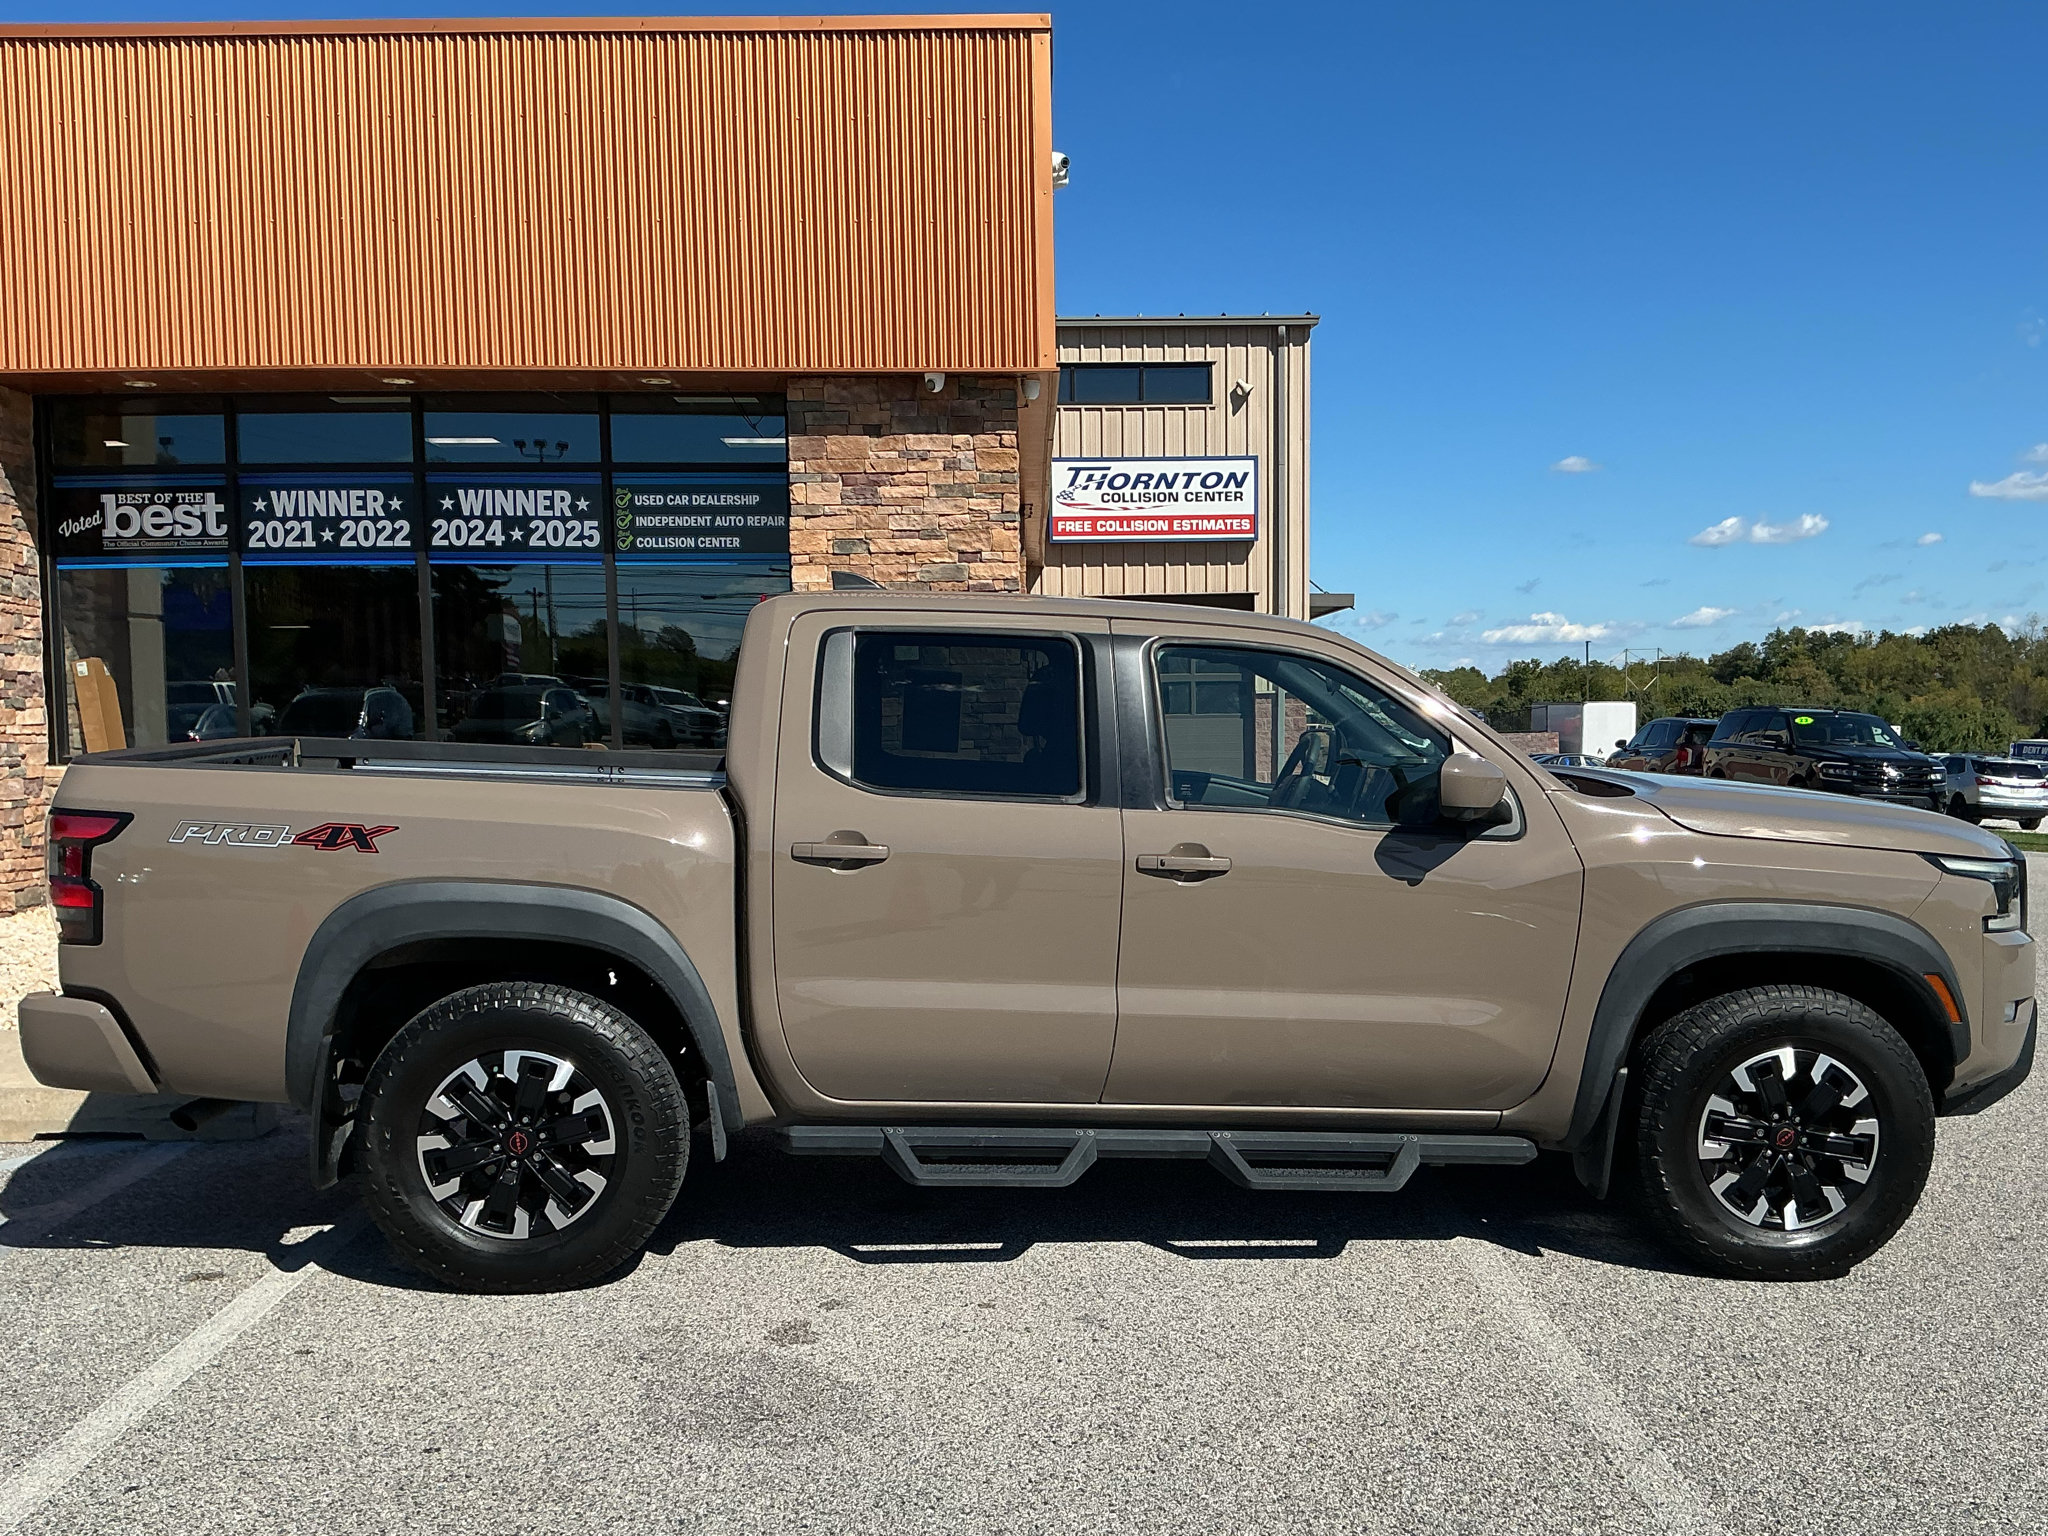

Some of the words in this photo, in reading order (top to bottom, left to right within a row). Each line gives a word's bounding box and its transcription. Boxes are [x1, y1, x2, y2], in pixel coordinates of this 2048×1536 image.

[1066, 466, 1249, 491] THORNTON
[117, 493, 151, 504] BEST
[155, 493, 171, 503] OF
[177, 493, 204, 503] THE
[270, 490, 385, 517] WINNER
[457, 489, 572, 516] WINNER
[634, 494, 664, 505] USED
[668, 494, 689, 505] CAR
[692, 494, 760, 506] DEALERSHIP
[1101, 492, 1179, 503] COLLISION
[1184, 491, 1243, 502] CENTER
[59, 510, 102, 537] Voted
[101, 493, 227, 537] best
[635, 516, 711, 527] INDEPENDENT
[715, 516, 744, 526] AUTO
[747, 516, 785, 526] REPAIR
[1057, 521, 1092, 532] FREE
[1096, 520, 1168, 531] COLLISION
[1173, 518, 1250, 530] ESTIMATES
[248, 520, 316, 547] 2021
[339, 520, 411, 547] 2022
[431, 519, 505, 546] 2024
[528, 519, 600, 547] 2025
[636, 537, 695, 548] COLLISION
[698, 537, 740, 548] CENTER
